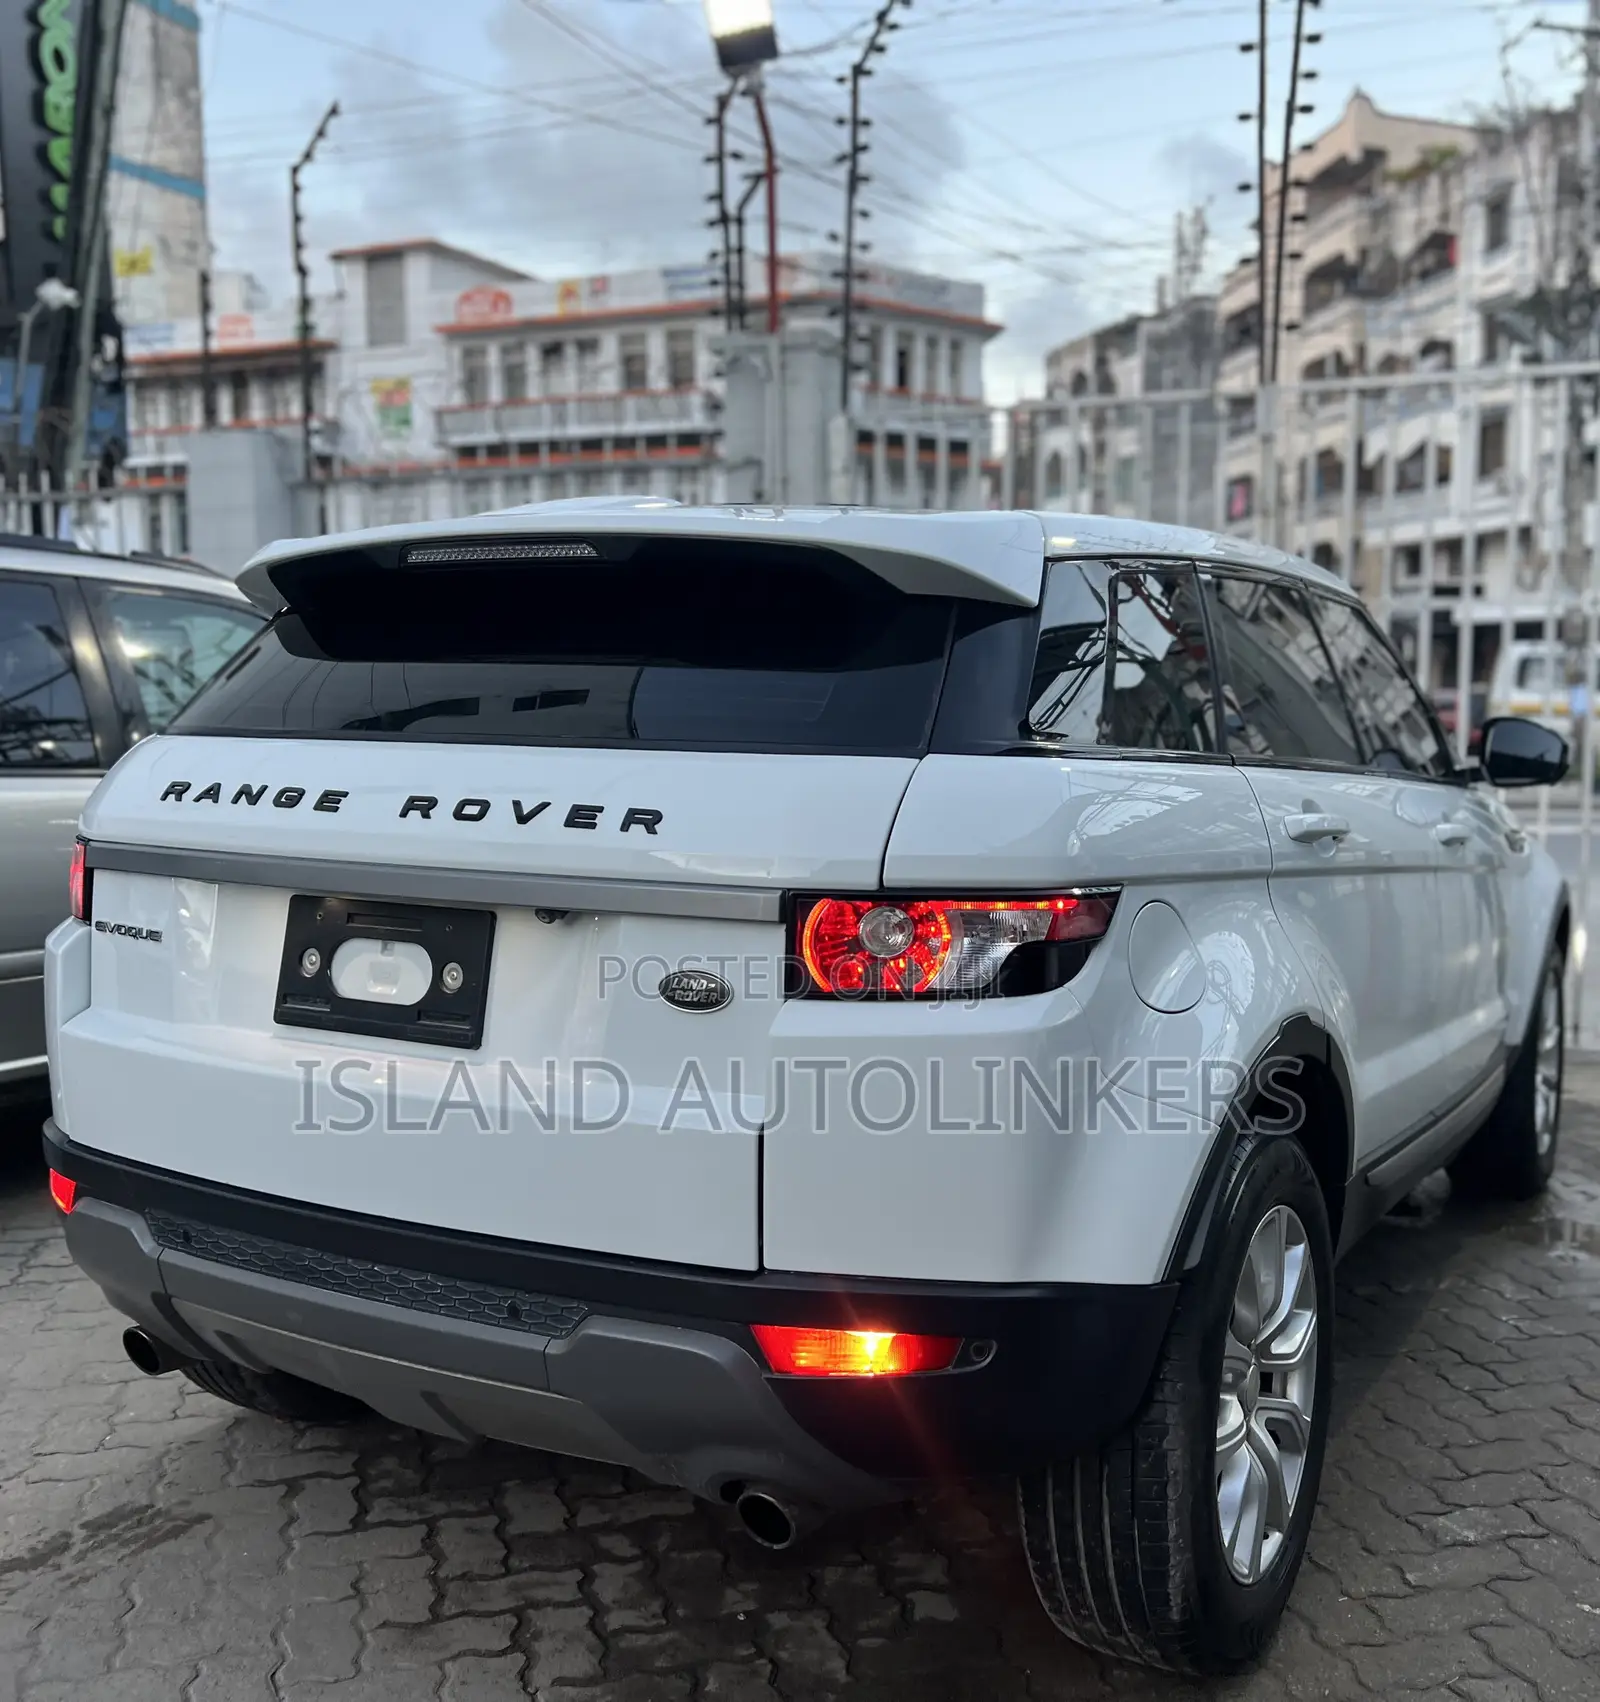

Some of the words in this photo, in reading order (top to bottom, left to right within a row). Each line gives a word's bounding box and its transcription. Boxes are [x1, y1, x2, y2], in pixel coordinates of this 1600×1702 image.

[160, 780, 350, 813] RANGE
[399, 794, 664, 836] ROVER
[95, 920, 163, 943] EVOQUE
